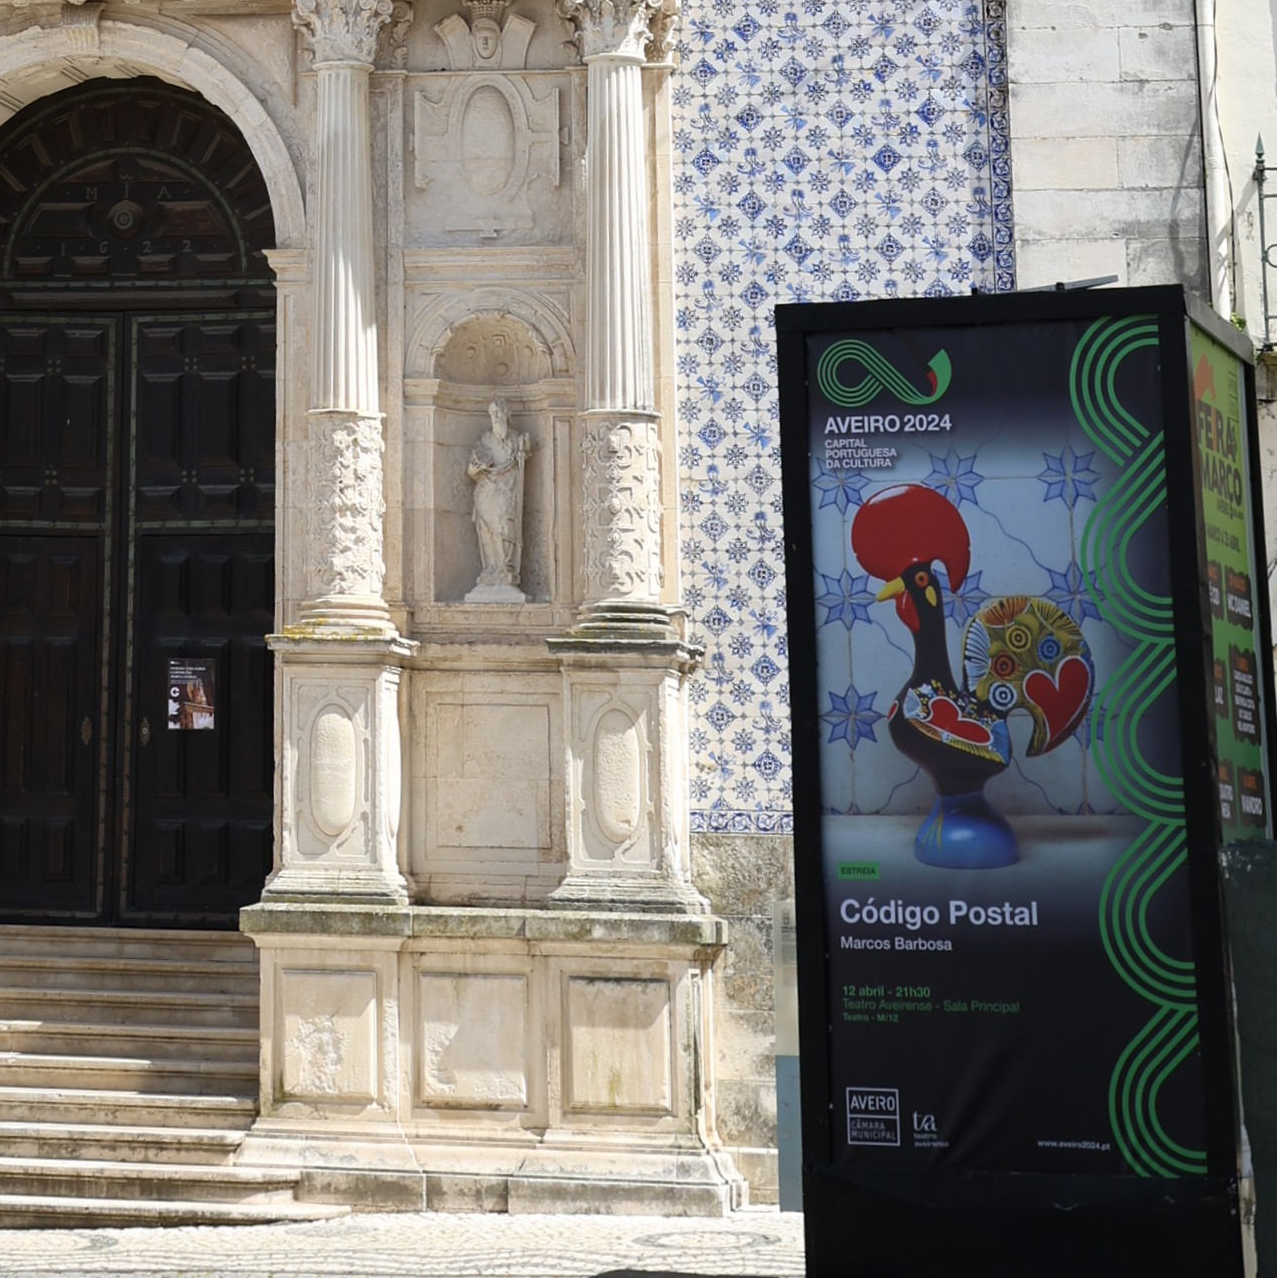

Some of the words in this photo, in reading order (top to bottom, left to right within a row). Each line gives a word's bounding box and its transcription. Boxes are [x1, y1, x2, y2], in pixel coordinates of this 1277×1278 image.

[824, 415, 900, 434] AVEIRO
[903, 414, 952, 432] 2024
[824, 438, 867, 449] CAPITAL
[825, 447, 898, 459] PORTUGUESA
[826, 458, 840, 469] DA
[842, 457, 892, 469] CULTURA
[841, 866, 876, 876] ESTREIA
[840, 897, 940, 930] Código
[948, 899, 1038, 926] Postal
[840, 935, 891, 950] Marcos
[894, 936, 953, 951] Barbosa
[842, 985, 856, 996] 12
[859, 985, 884, 997] abril
[896, 986, 931, 998] 21h30
[842, 997, 876, 1010] Teatro
[878, 999, 932, 1012] Aveirense
[943, 1000, 968, 1012] Sala
[971, 1001, 1021, 1014] Principal
[850, 1094, 896, 1112] AVEIRO
[850, 1118, 885, 1130] CÂMARA
[850, 1130, 896, 1141] MUNICIPAL
